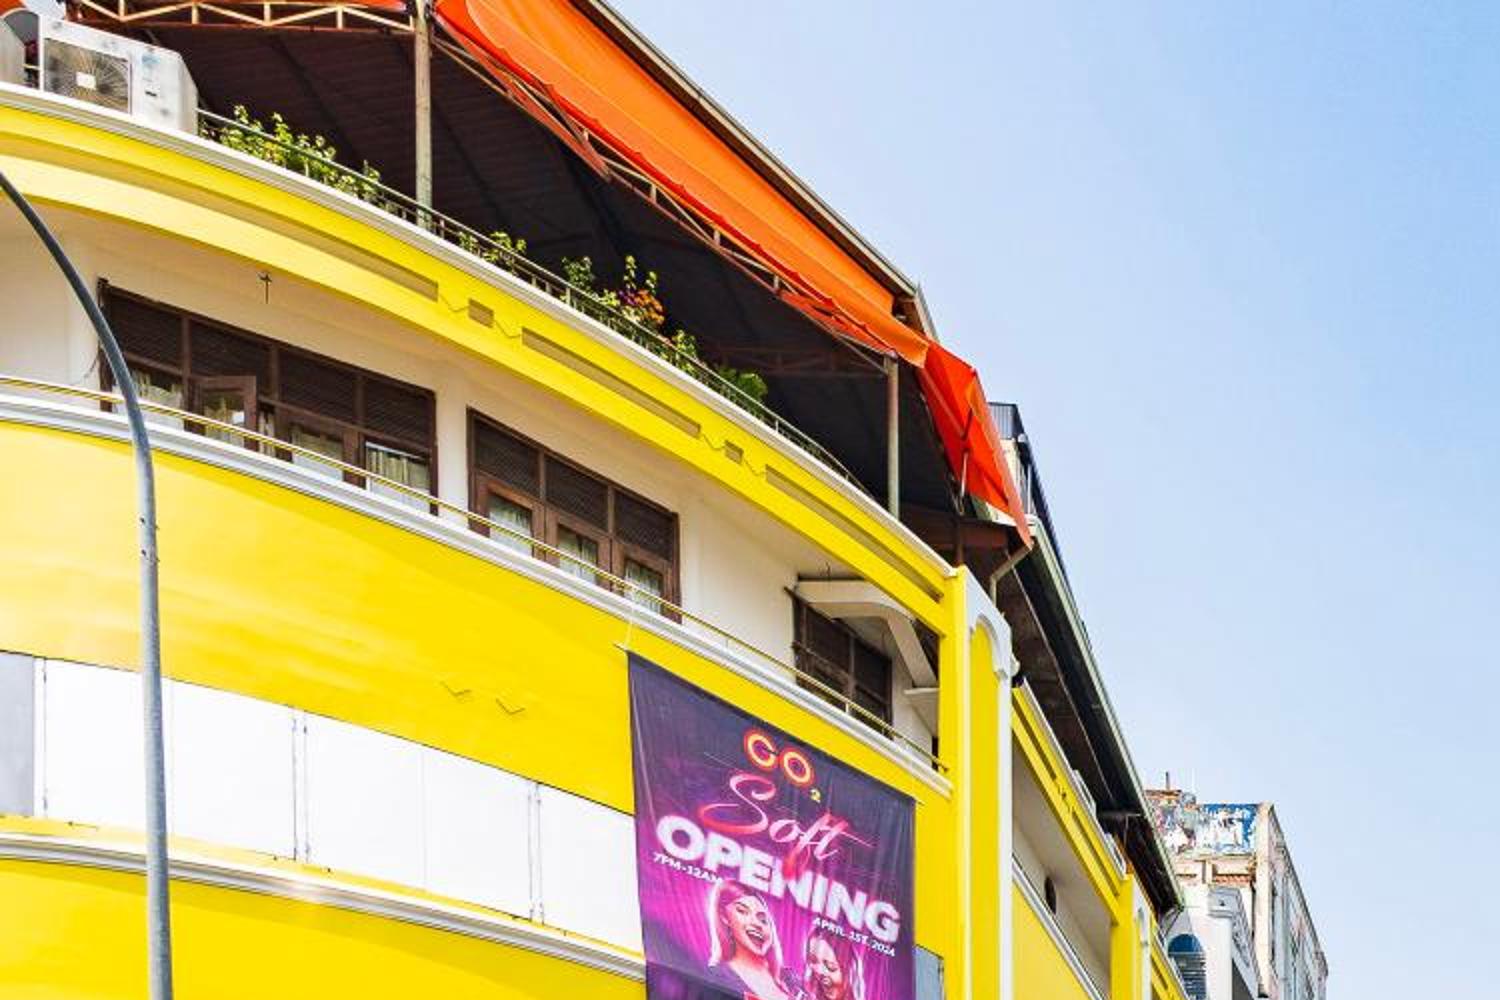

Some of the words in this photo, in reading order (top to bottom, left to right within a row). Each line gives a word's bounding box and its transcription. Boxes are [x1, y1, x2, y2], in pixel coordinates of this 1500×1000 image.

[698, 771, 875, 876] Soft
[656, 815, 900, 943] OPENING
[813, 916, 845, 938] APRIL
